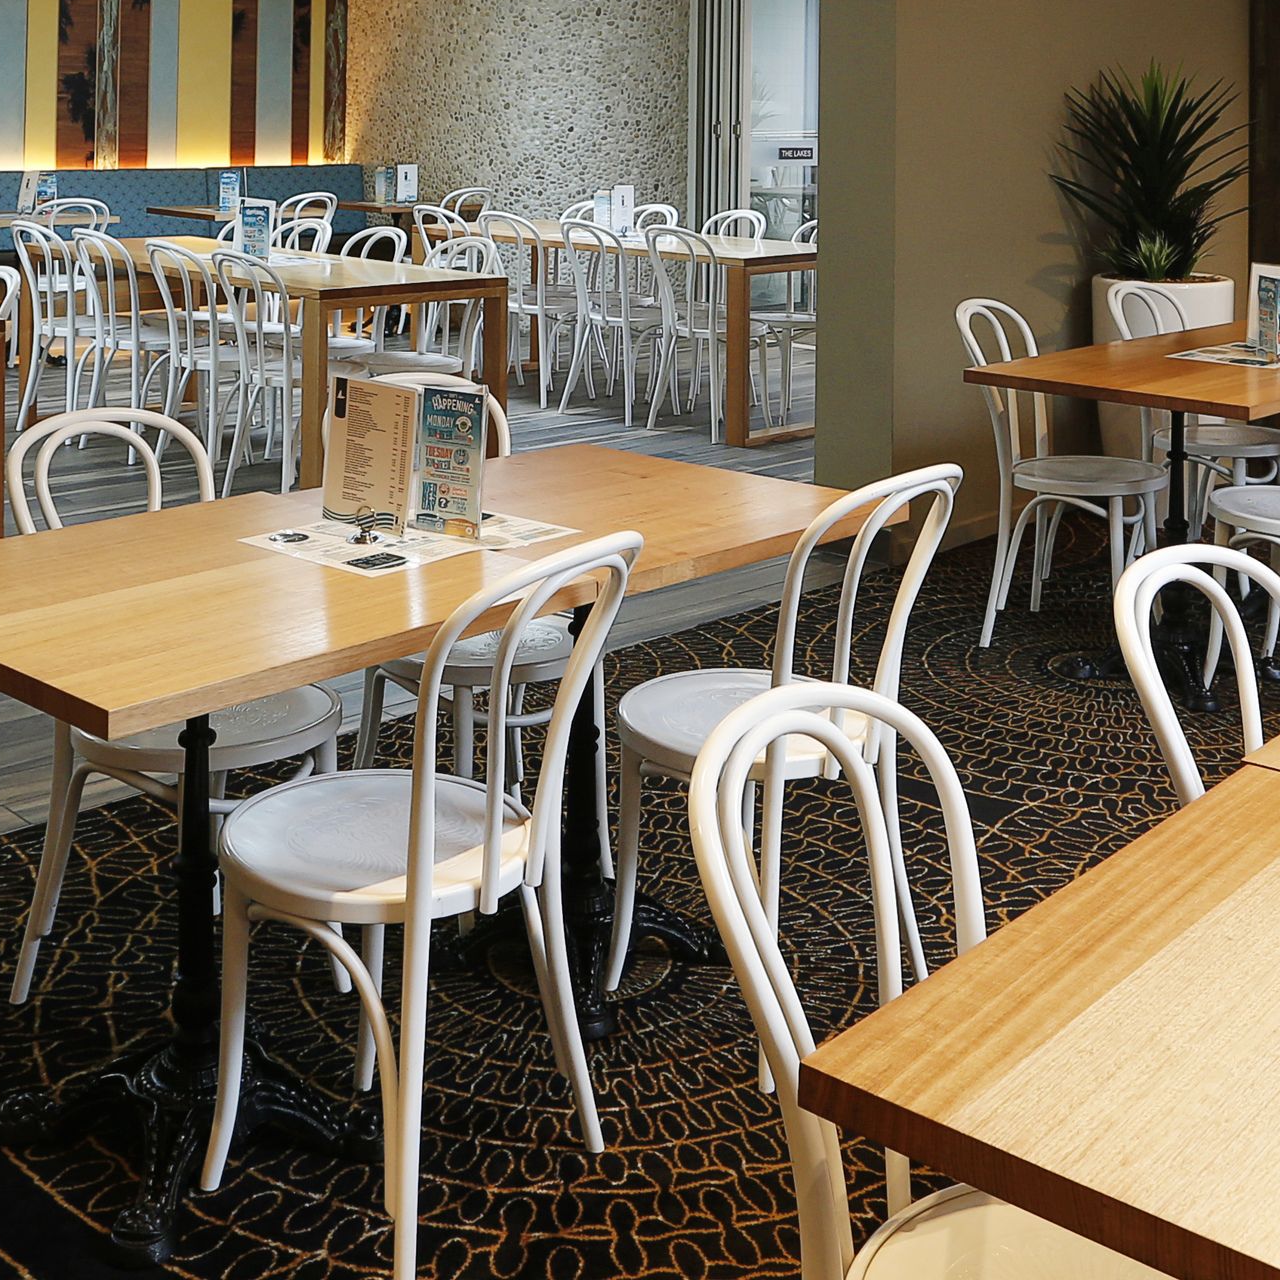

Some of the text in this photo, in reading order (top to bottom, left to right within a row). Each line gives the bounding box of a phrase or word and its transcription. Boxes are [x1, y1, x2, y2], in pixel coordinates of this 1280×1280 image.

[781, 150, 812, 158] THE LAKES
[431, 396, 474, 414] HAPPENING
[426, 414, 455, 428] MONDAY
